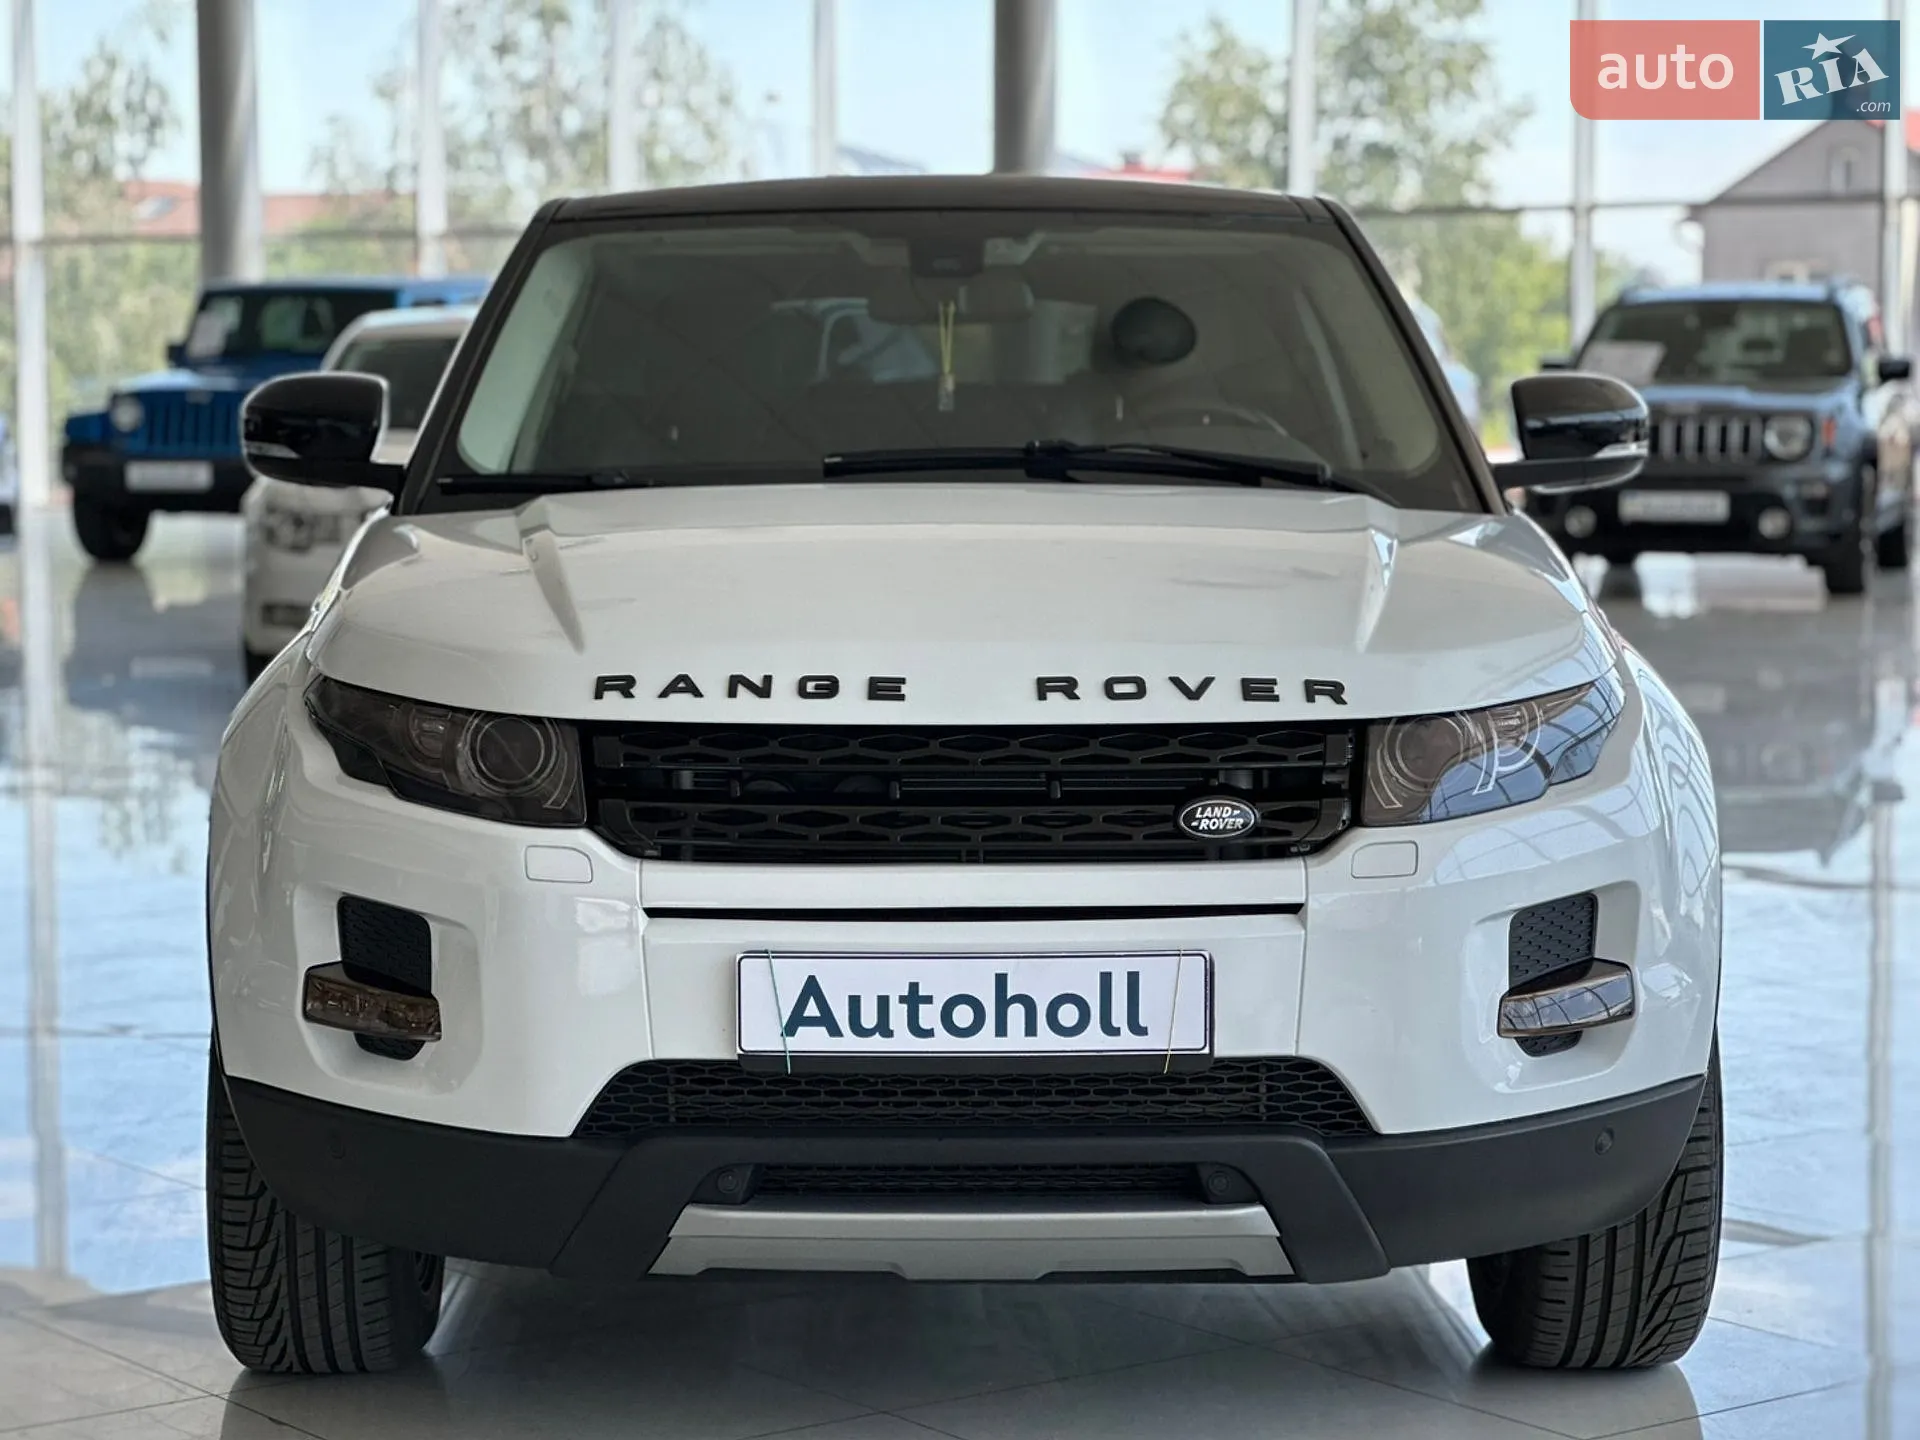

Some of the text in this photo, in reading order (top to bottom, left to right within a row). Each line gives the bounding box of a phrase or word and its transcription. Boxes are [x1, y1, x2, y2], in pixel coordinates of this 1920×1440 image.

[594, 674, 1348, 705] RANGE ROVER
[1195, 806, 1232, 818] LAND
[1199, 818, 1244, 830] ROVER
[780, 970, 1149, 1038] Autoholl
